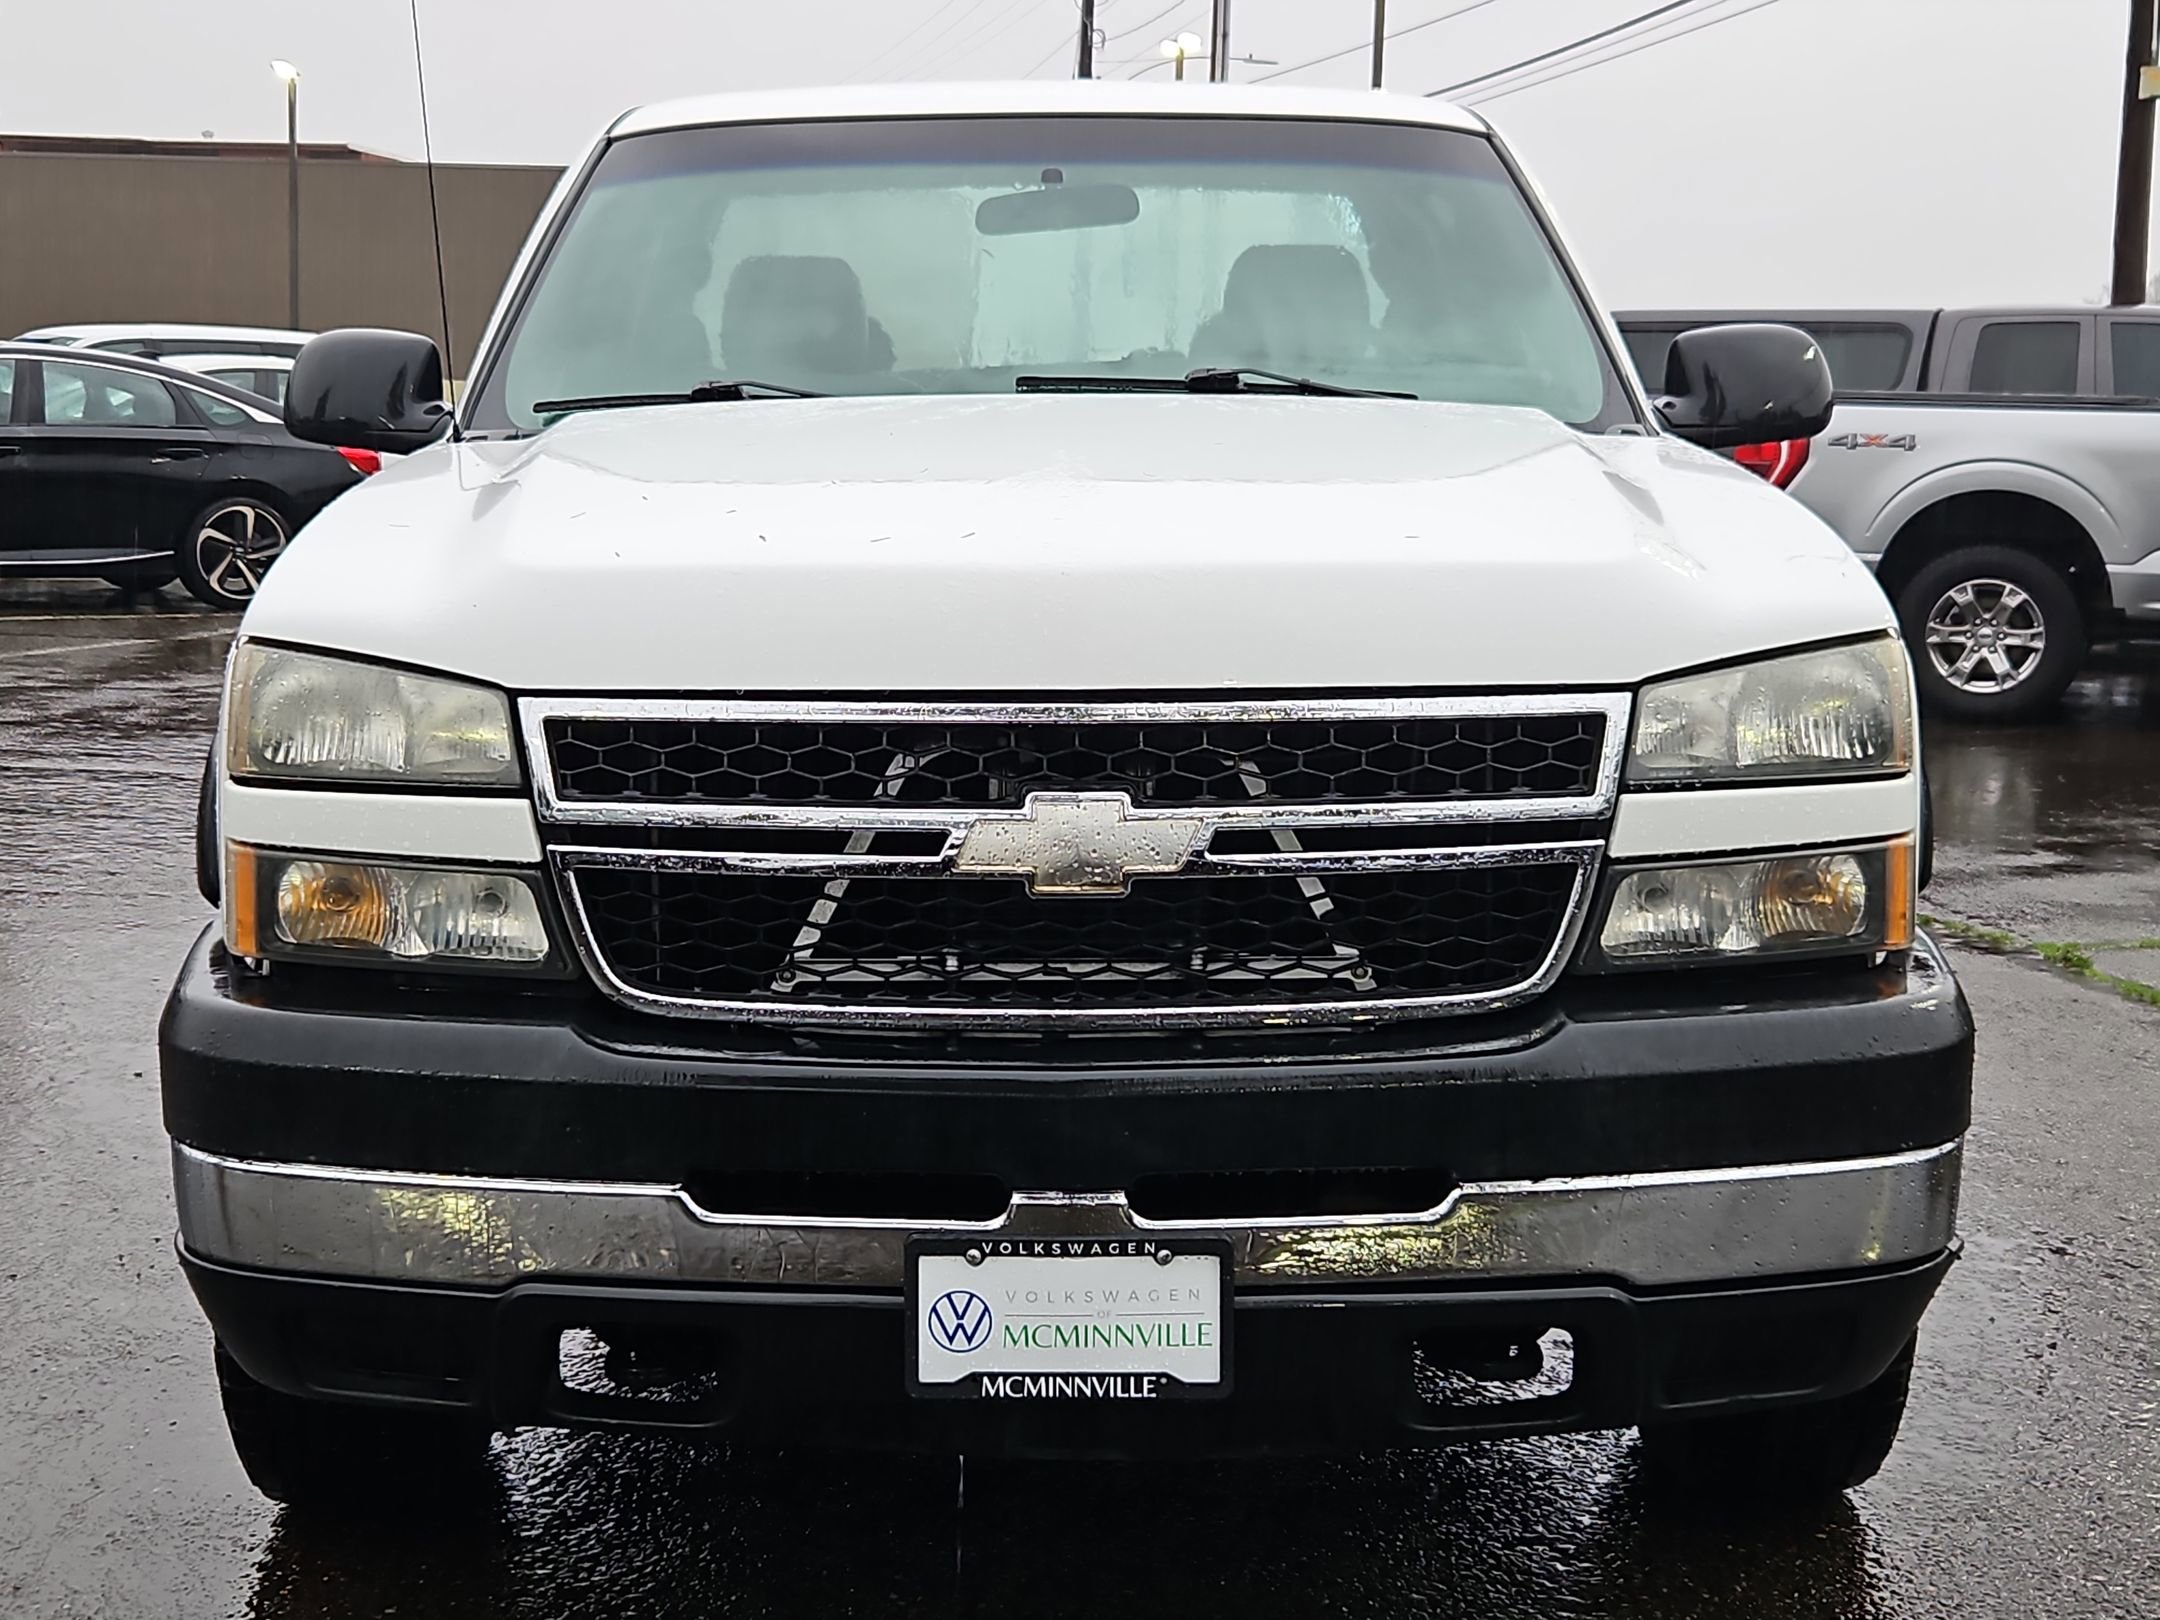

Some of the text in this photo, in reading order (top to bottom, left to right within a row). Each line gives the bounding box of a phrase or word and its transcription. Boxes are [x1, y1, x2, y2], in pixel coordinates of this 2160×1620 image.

[982, 1242, 1156, 1255] VOLKSWAGEN
[1005, 1288, 1201, 1304] VOLKSWAGEN
[1096, 1310, 1111, 1319] OF
[1003, 1323, 1213, 1349] MCMINNVILLE
[981, 1376, 1157, 1398] MCMINNVILLE
